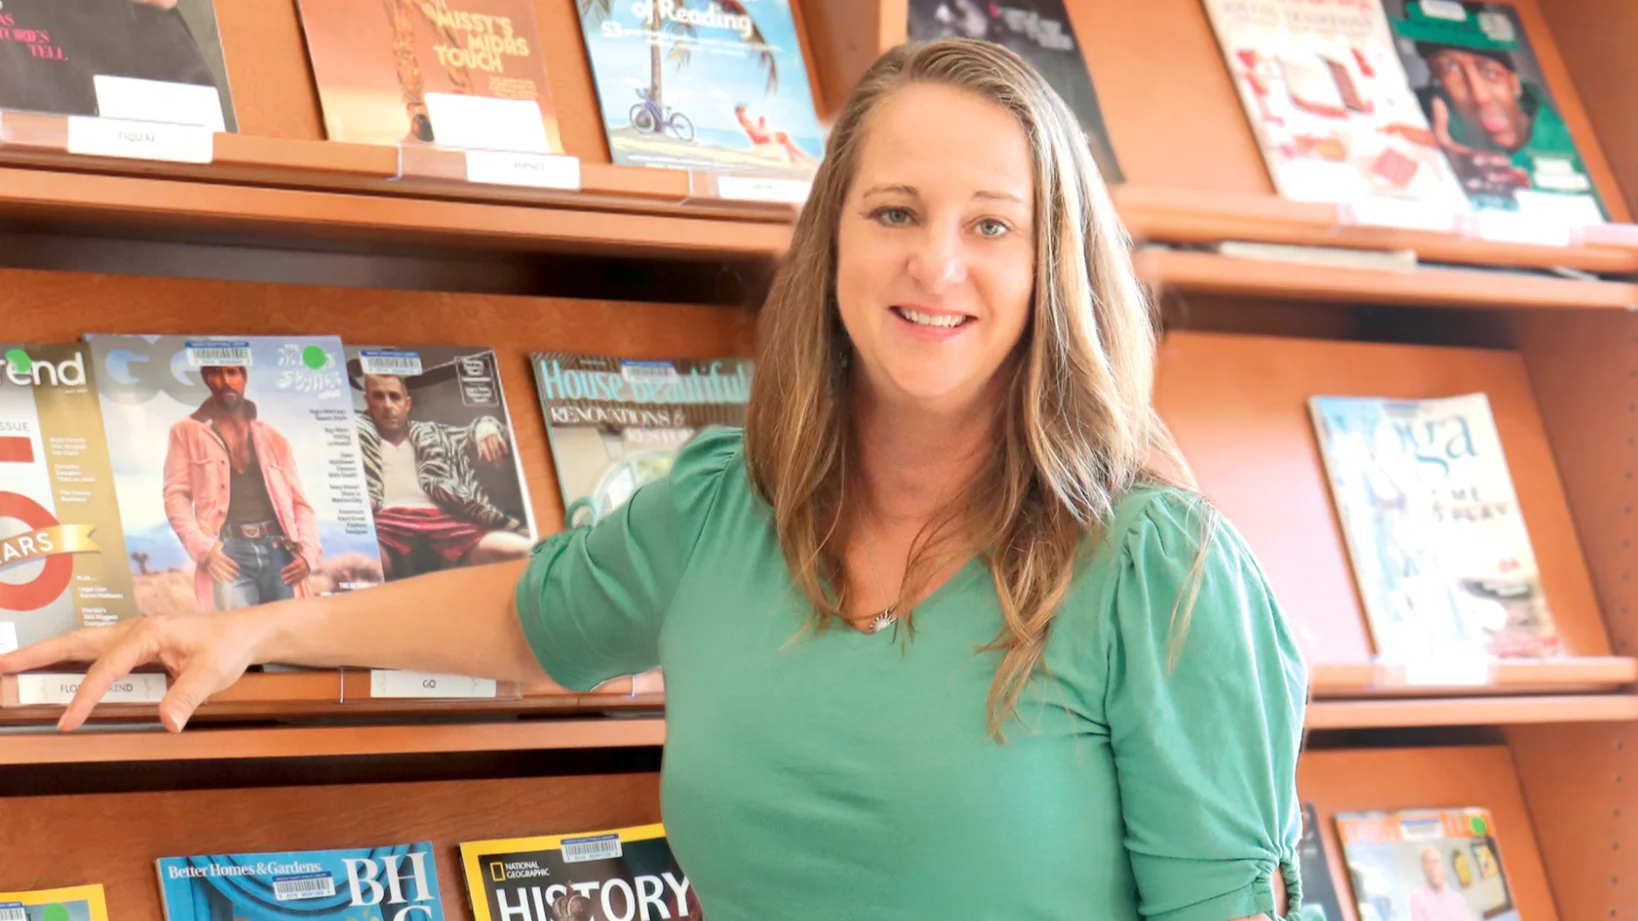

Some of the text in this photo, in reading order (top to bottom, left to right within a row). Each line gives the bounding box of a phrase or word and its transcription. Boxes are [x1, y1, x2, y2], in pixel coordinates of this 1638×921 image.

[435, 10, 513, 37] MISSY'S
[658, 0, 753, 40] Reading
[468, 33, 530, 57] MIDAS
[432, 44, 503, 73] TOUCH
[540, 359, 623, 402] House
[551, 406, 671, 426] RENOVATIONS
[0, 531, 54, 562] ARS
[422, 679, 437, 690] GQ
[168, 859, 322, 879] Better Homes & Gardens
[505, 860, 540, 871] NATIONAL
[506, 868, 551, 879] GEOGRAPHIC
[341, 851, 436, 907] BH
